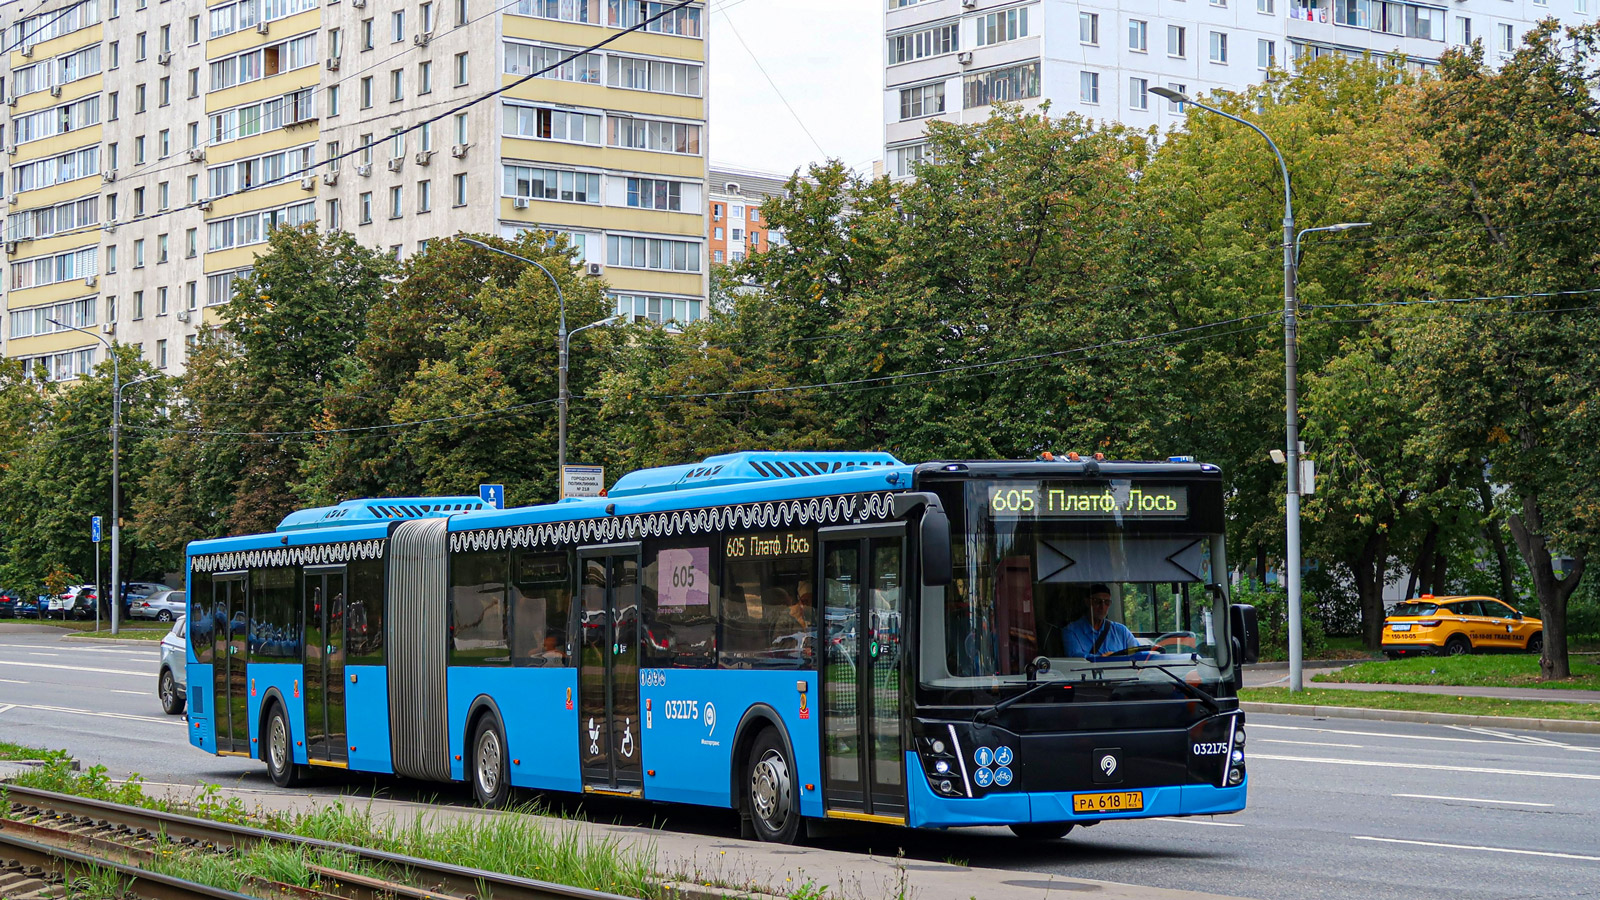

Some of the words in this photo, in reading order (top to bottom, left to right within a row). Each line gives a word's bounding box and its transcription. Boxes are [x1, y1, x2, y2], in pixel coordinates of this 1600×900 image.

[992, 490, 1035, 511] 605
[1048, 490, 1119, 512] Платф.
[1126, 490, 1177, 511] Лось
[726, 537, 745, 557] 605
[750, 536, 782, 556] Платф.
[785, 534, 809, 554] Лось
[672, 566, 695, 588] 605
[665, 700, 698, 719] 032175
[1193, 743, 1228, 755] 032175
[1099, 795, 1120, 808] 618
[1127, 793, 1138, 803] 77
